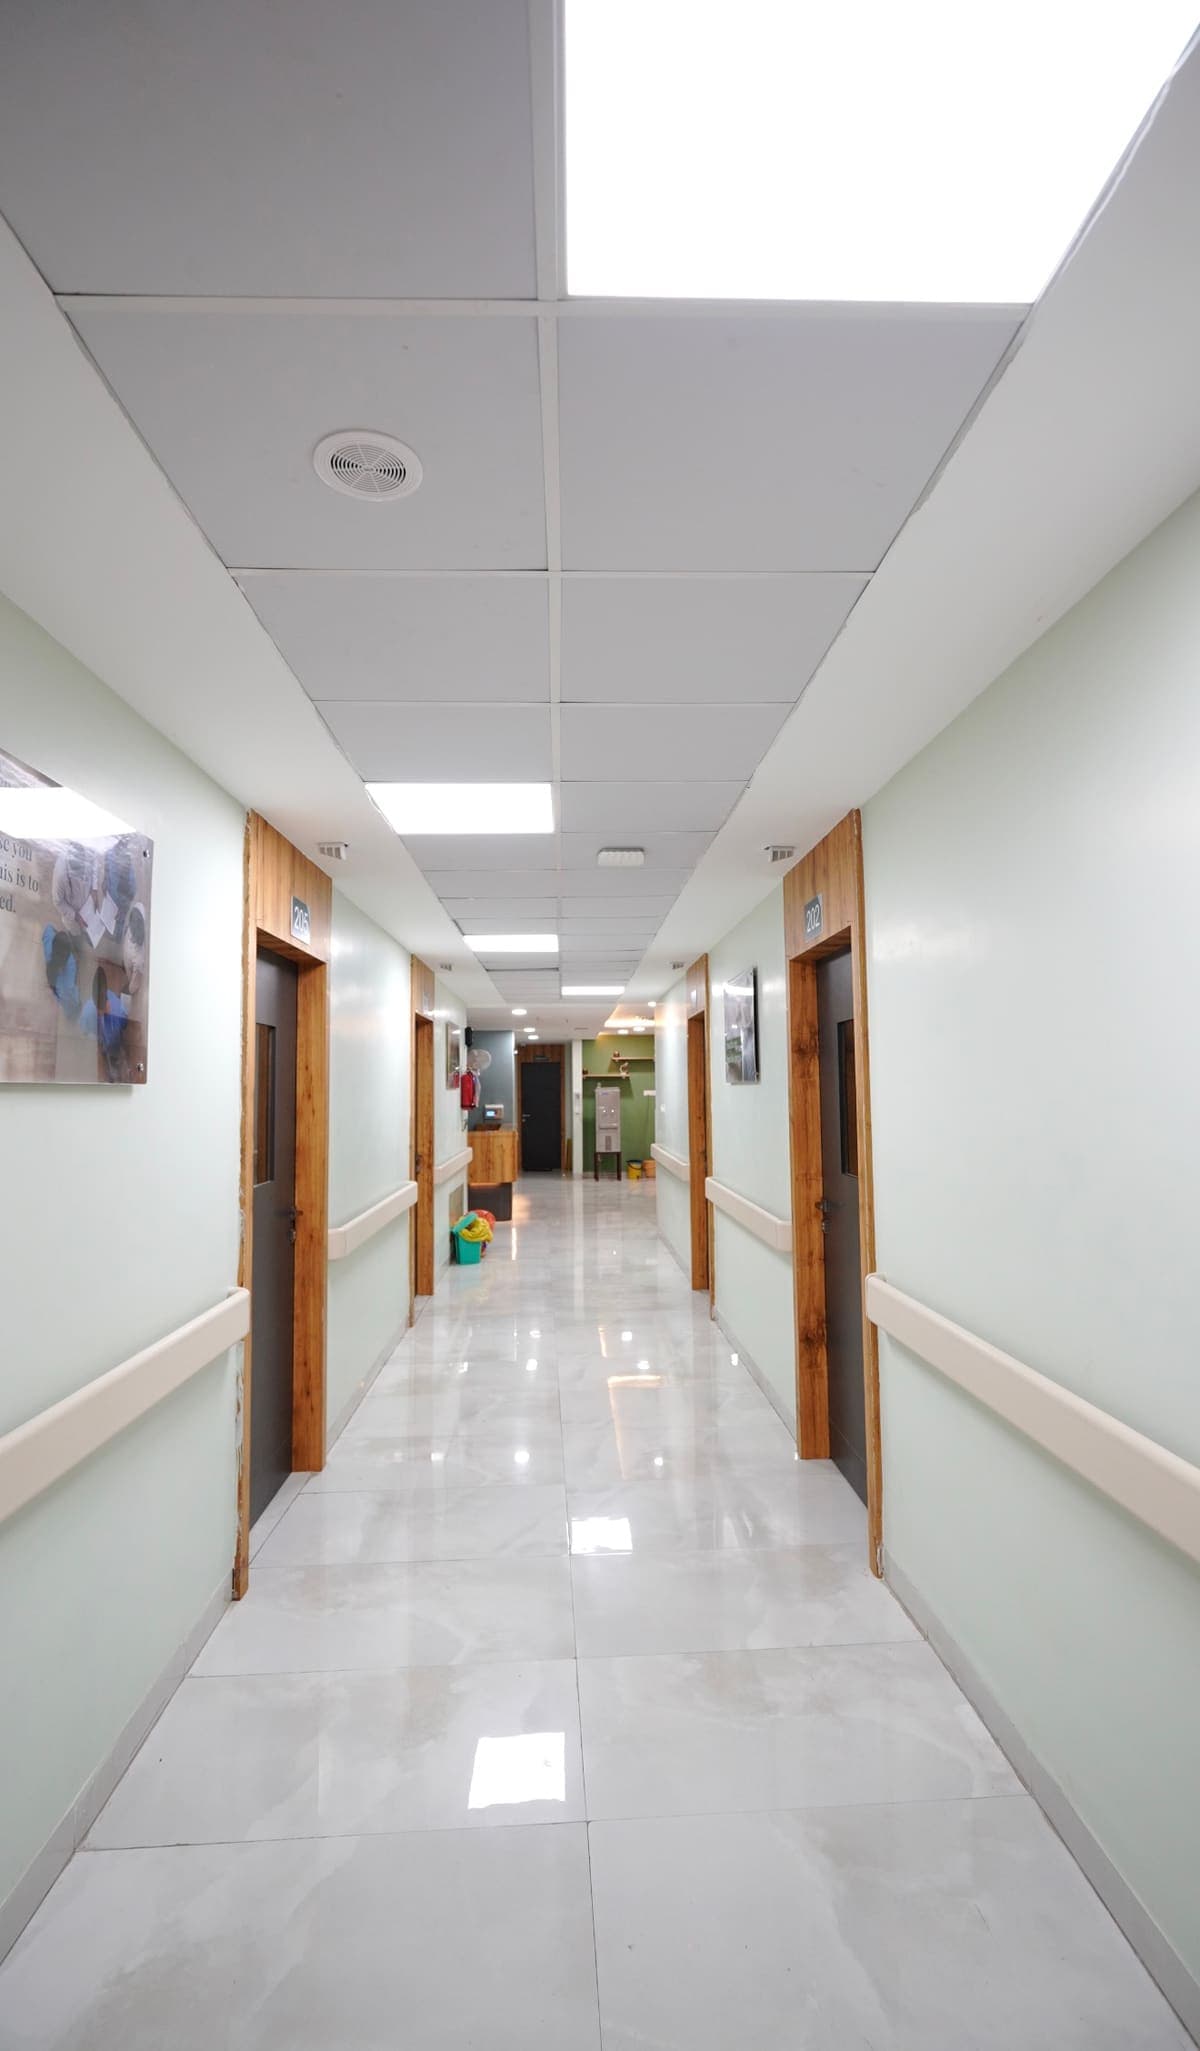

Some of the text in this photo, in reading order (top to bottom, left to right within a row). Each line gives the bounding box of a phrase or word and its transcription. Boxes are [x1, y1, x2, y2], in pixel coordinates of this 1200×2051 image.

[12, 842, 32, 861] you
[16, 868, 25, 887] is
[28, 875, 39, 893] to
[295, 906, 309, 933] 205
[806, 904, 820, 933] 202
